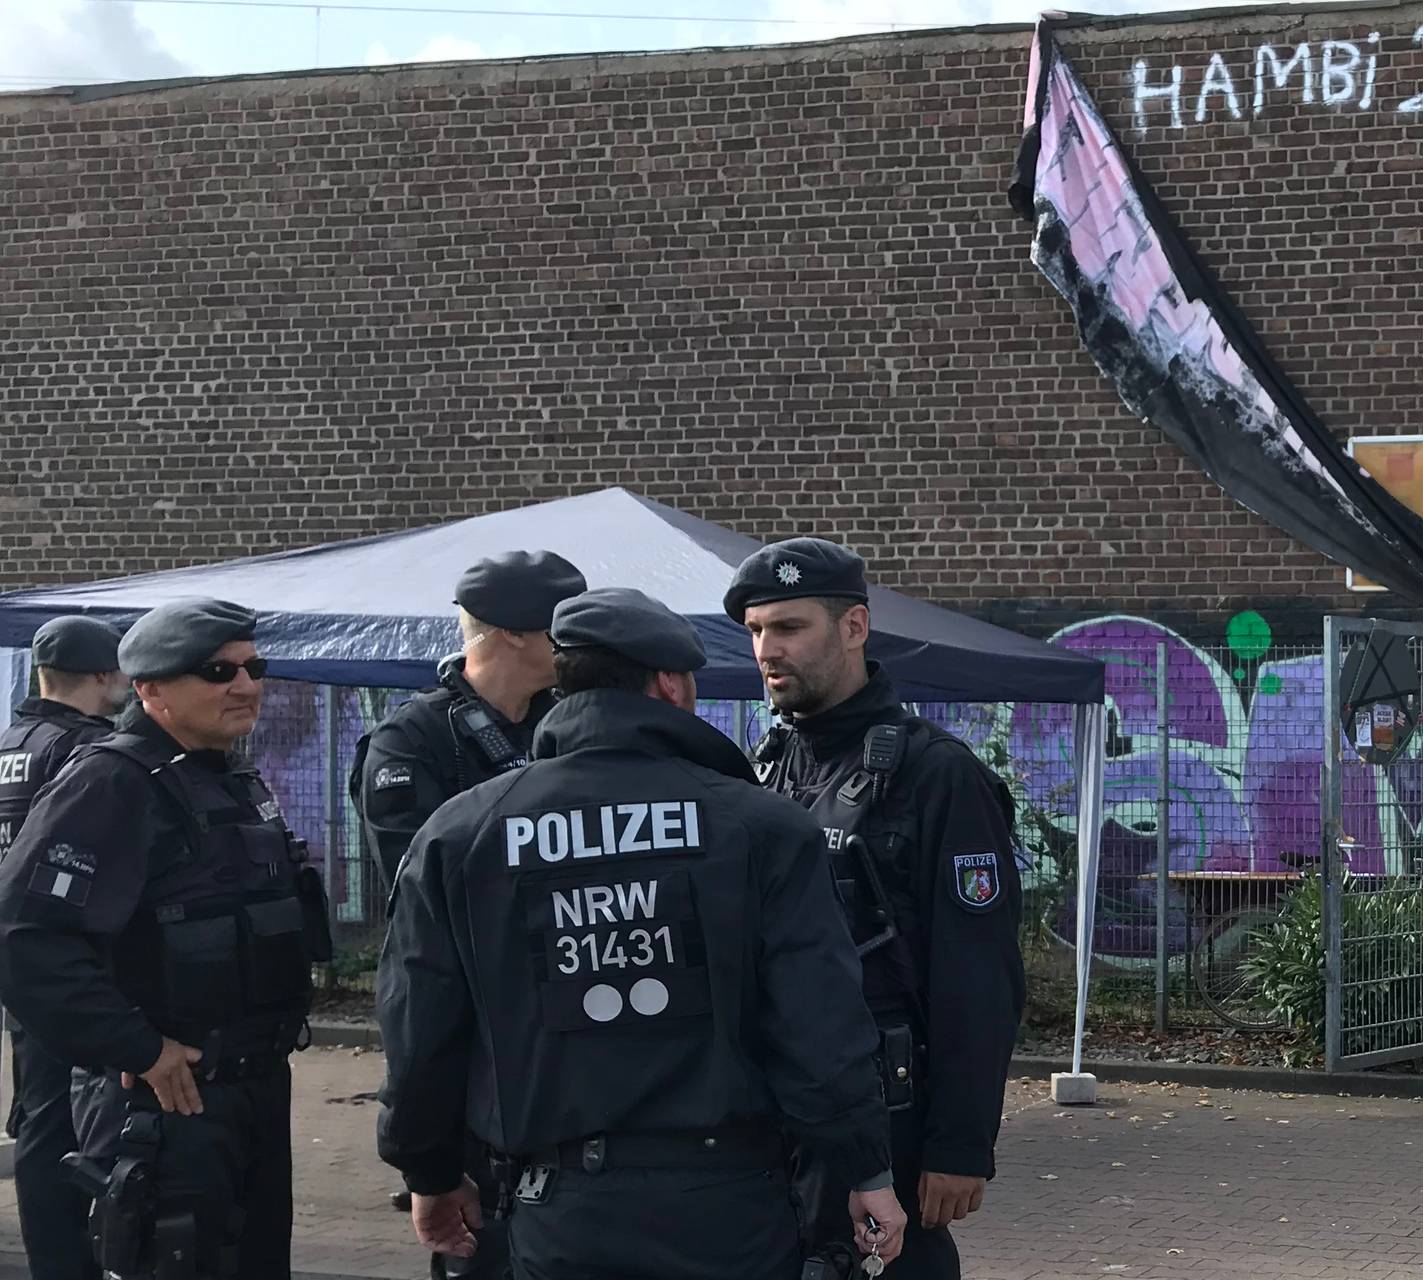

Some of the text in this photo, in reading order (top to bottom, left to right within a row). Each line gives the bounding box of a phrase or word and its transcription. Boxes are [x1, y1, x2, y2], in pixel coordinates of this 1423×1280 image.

[506, 801, 700, 867] POLIZEI
[957, 855, 995, 868] POLIZEI
[551, 879, 658, 929] NRW
[556, 926, 675, 975] 31431
